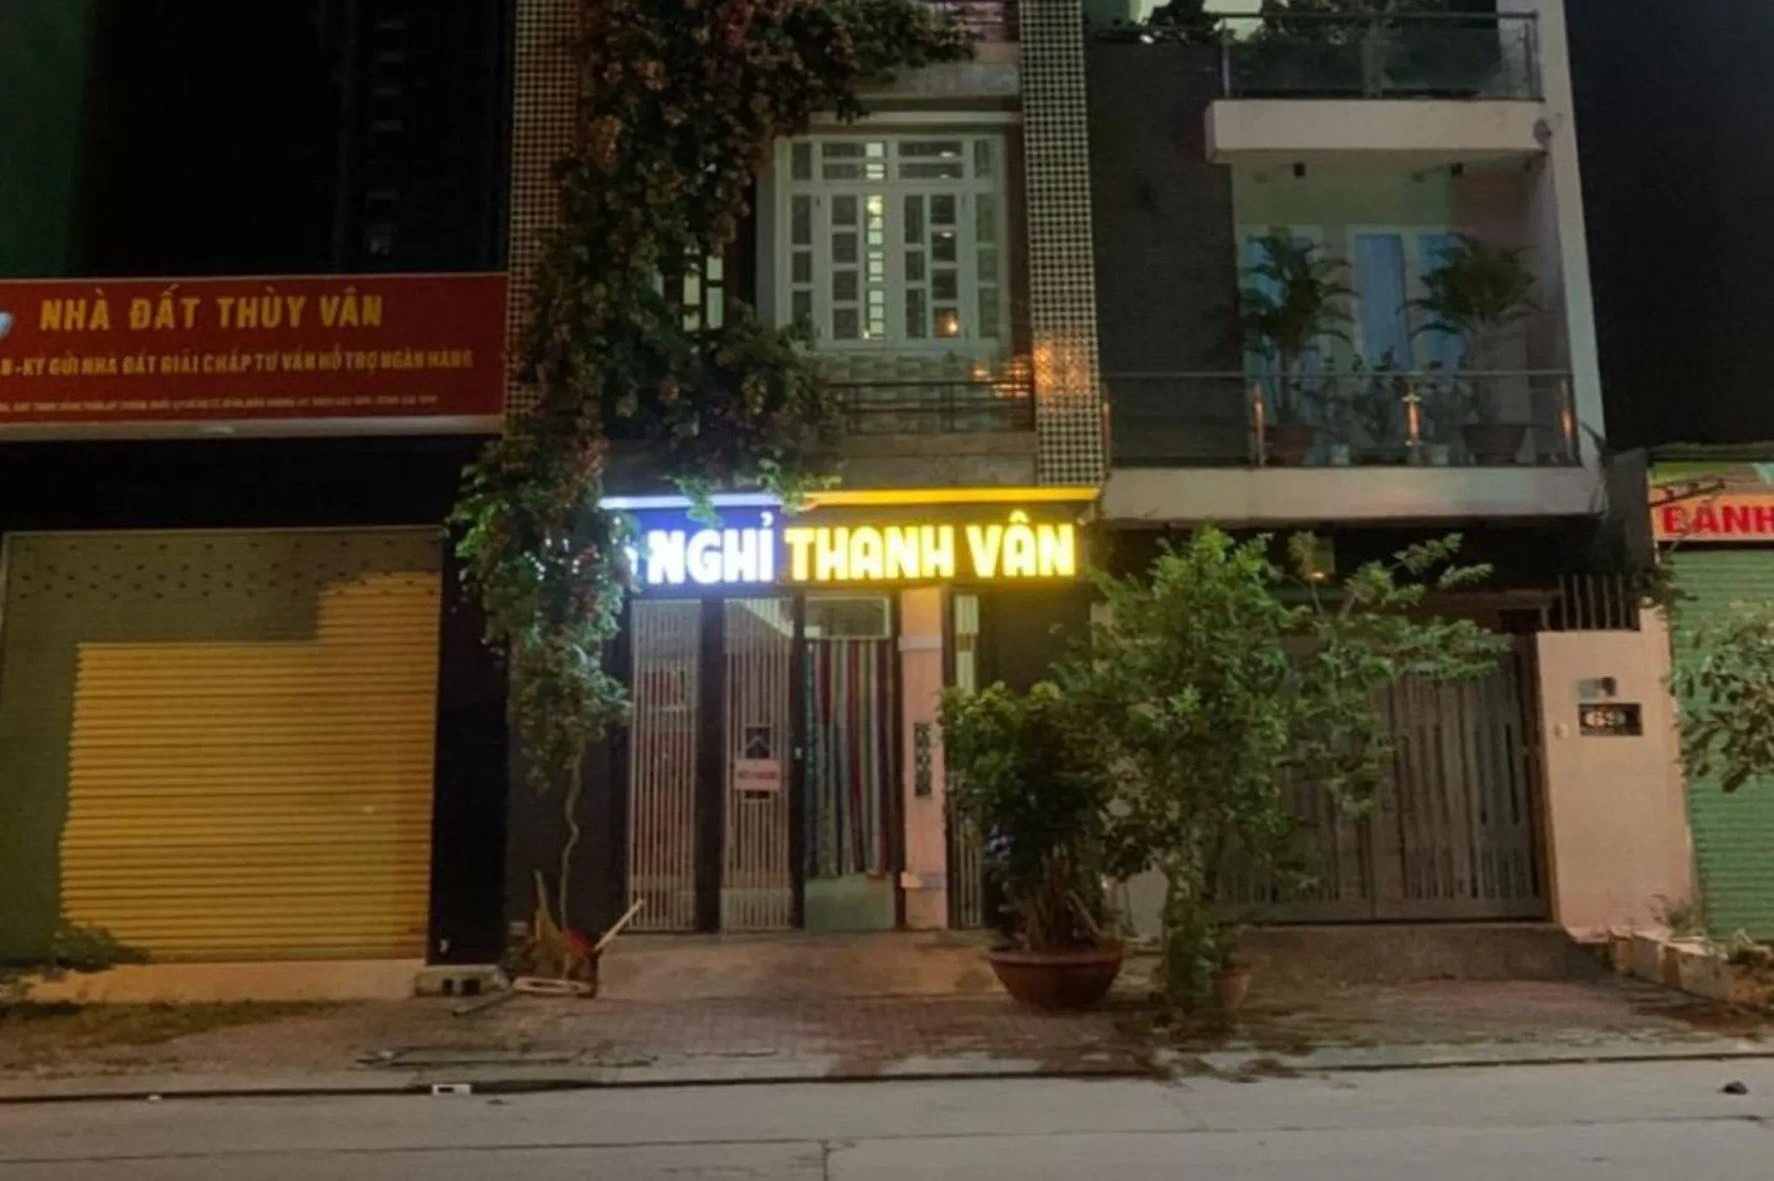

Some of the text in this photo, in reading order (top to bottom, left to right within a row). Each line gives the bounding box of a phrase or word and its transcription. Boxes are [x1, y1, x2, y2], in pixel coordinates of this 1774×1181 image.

[40, 283, 384, 332] NHÀ ĐẤT THÙY VÂN
[647, 511, 774, 584] NGHỈ
[784, 525, 955, 582] THANH
[967, 509, 1076, 580] VÂN
